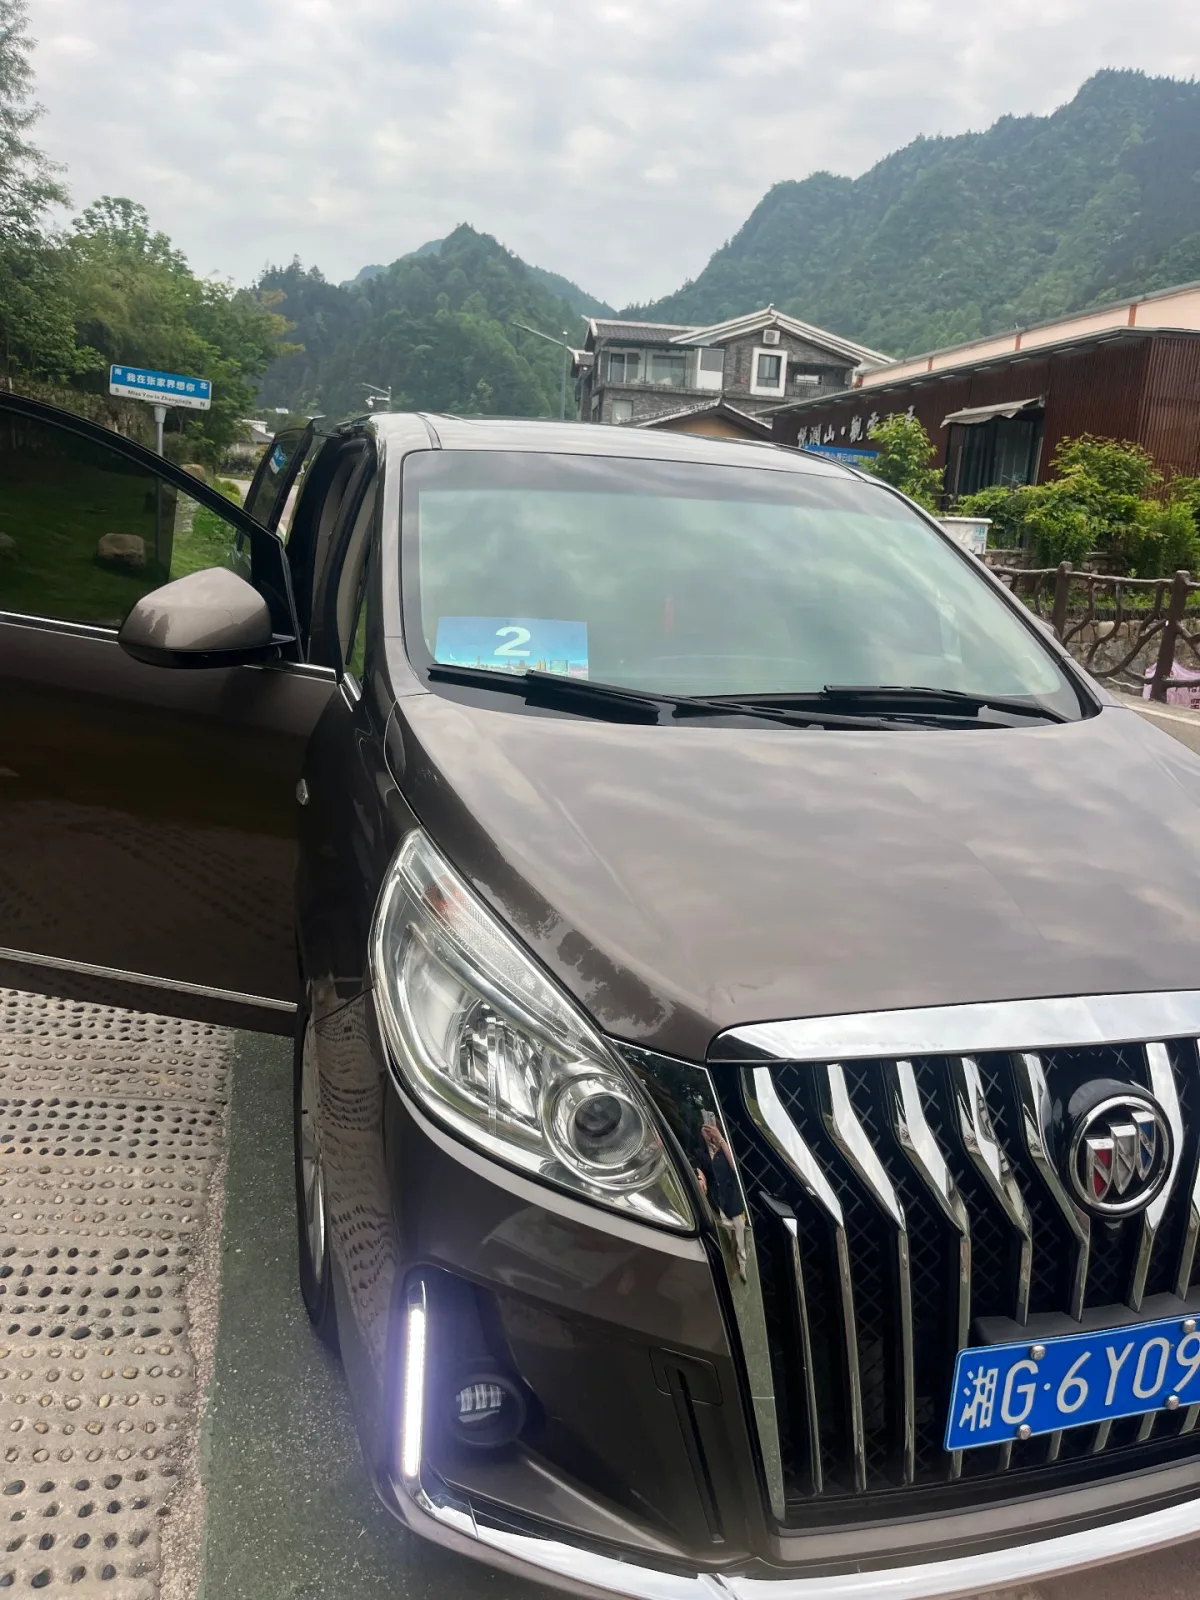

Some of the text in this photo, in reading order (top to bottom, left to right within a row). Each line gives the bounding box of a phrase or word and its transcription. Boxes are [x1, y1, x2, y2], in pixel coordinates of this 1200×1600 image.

[126, 372, 195, 392] 我在张家界想你
[200, 382, 208, 390] 北
[128, 389, 141, 397] Miss
[494, 626, 531, 657] 2
